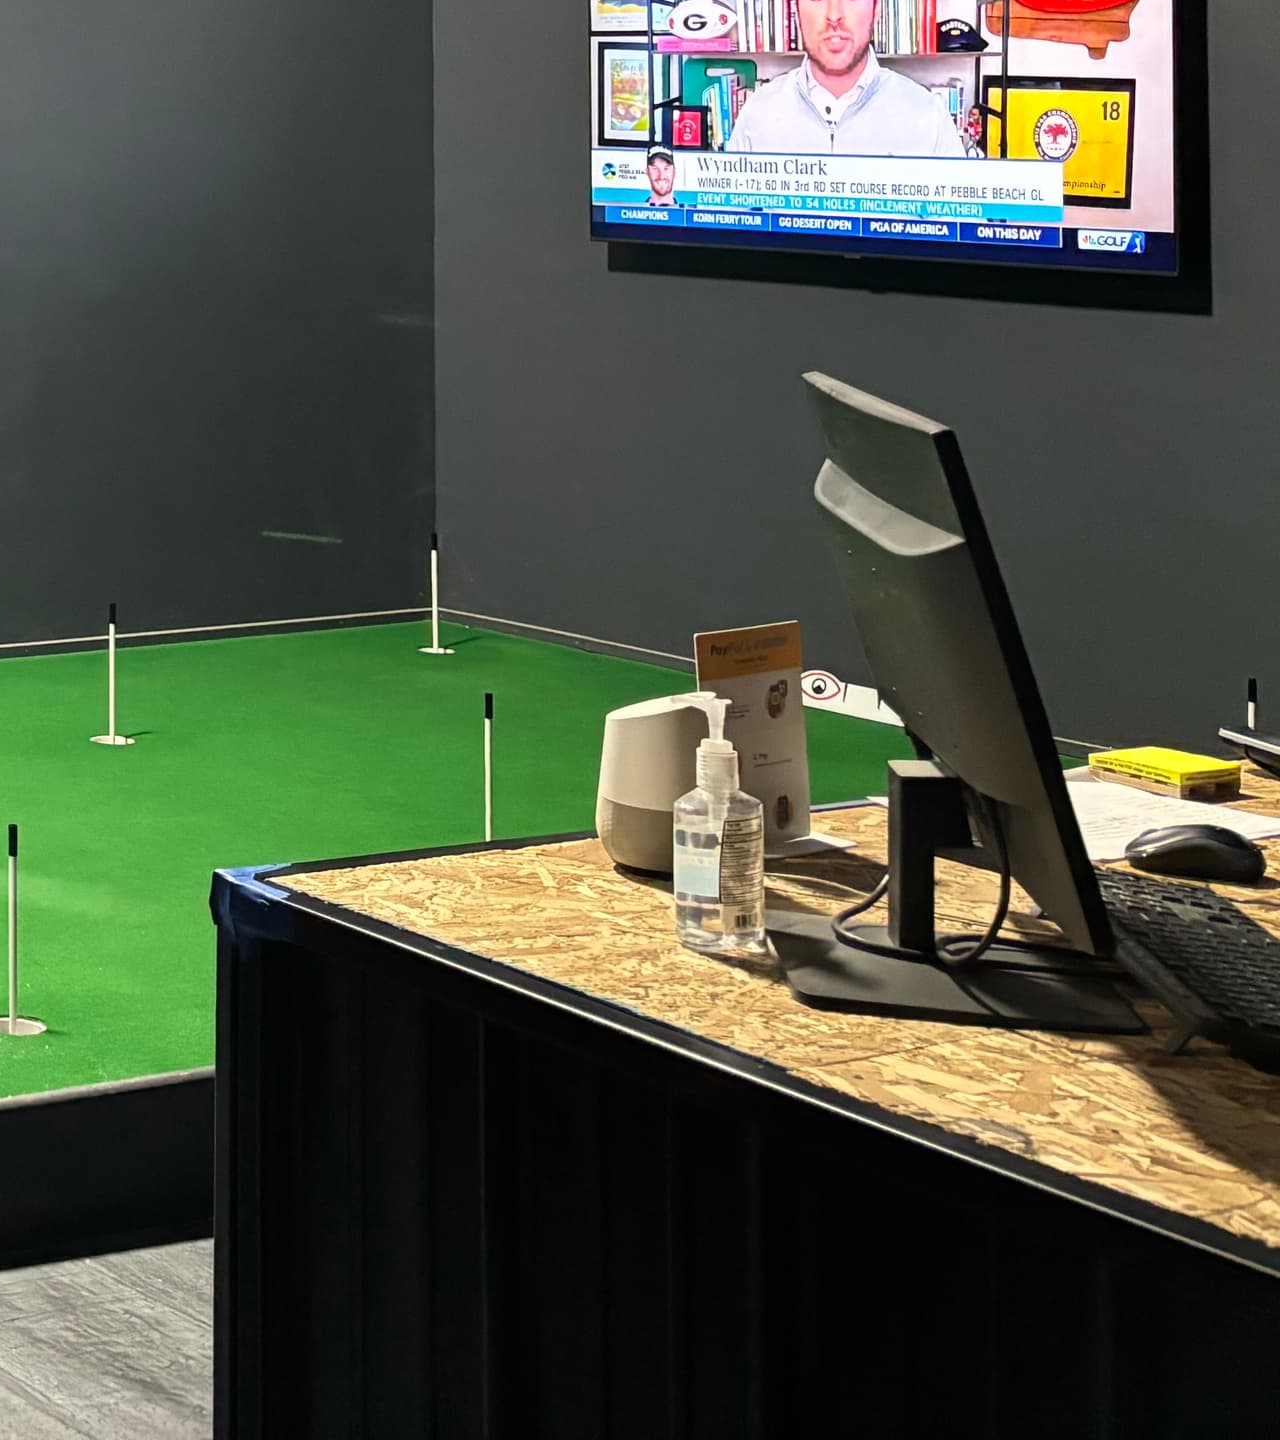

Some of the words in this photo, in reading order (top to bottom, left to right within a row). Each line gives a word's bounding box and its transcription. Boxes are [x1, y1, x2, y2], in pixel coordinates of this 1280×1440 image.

[1101, 101, 1121, 121] 18
[697, 157, 782, 175] Wyndham
[783, 159, 828, 176] Clark
[697, 178, 731, 190] WINNER
[765, 179, 776, 191] 60
[780, 180, 790, 191] IN
[795, 180, 809, 192] 3rd
[813, 181, 826, 193] RD
[830, 182, 846, 194] SET
[850, 183, 887, 196] COURSE
[891, 184, 930, 197] RECORD
[934, 185, 947, 197] AT
[951, 186, 988, 199] PEBBLE
[992, 188, 1026, 201] BEACH
[1031, 189, 1044, 202] GL
[697, 193, 726, 205] EVENT
[729, 194, 785, 207] SHORTENED
[790, 197, 802, 208] TO
[805, 197, 819, 209] 54
[823, 198, 856, 210] HOLES
[860, 200, 922, 215] (INCLEMENT
[926, 202, 983, 217] WEATHER)
[620, 209, 669, 221] CHAMPIONS
[693, 213, 714, 223] KORN
[715, 214, 739, 225] FERRY
[739, 215, 762, 226] TOUR
[793, 218, 826, 229] DESERT
[826, 219, 852, 231] OPEN
[870, 220, 891, 232] PGA
[891, 222, 904, 233] OF
[903, 222, 949, 236] AMERICA
[977, 227, 995, 238] ON
[995, 228, 1019, 239] THIS
[1019, 229, 1041, 241] DAY
[1097, 236, 1127, 247] GOLF
